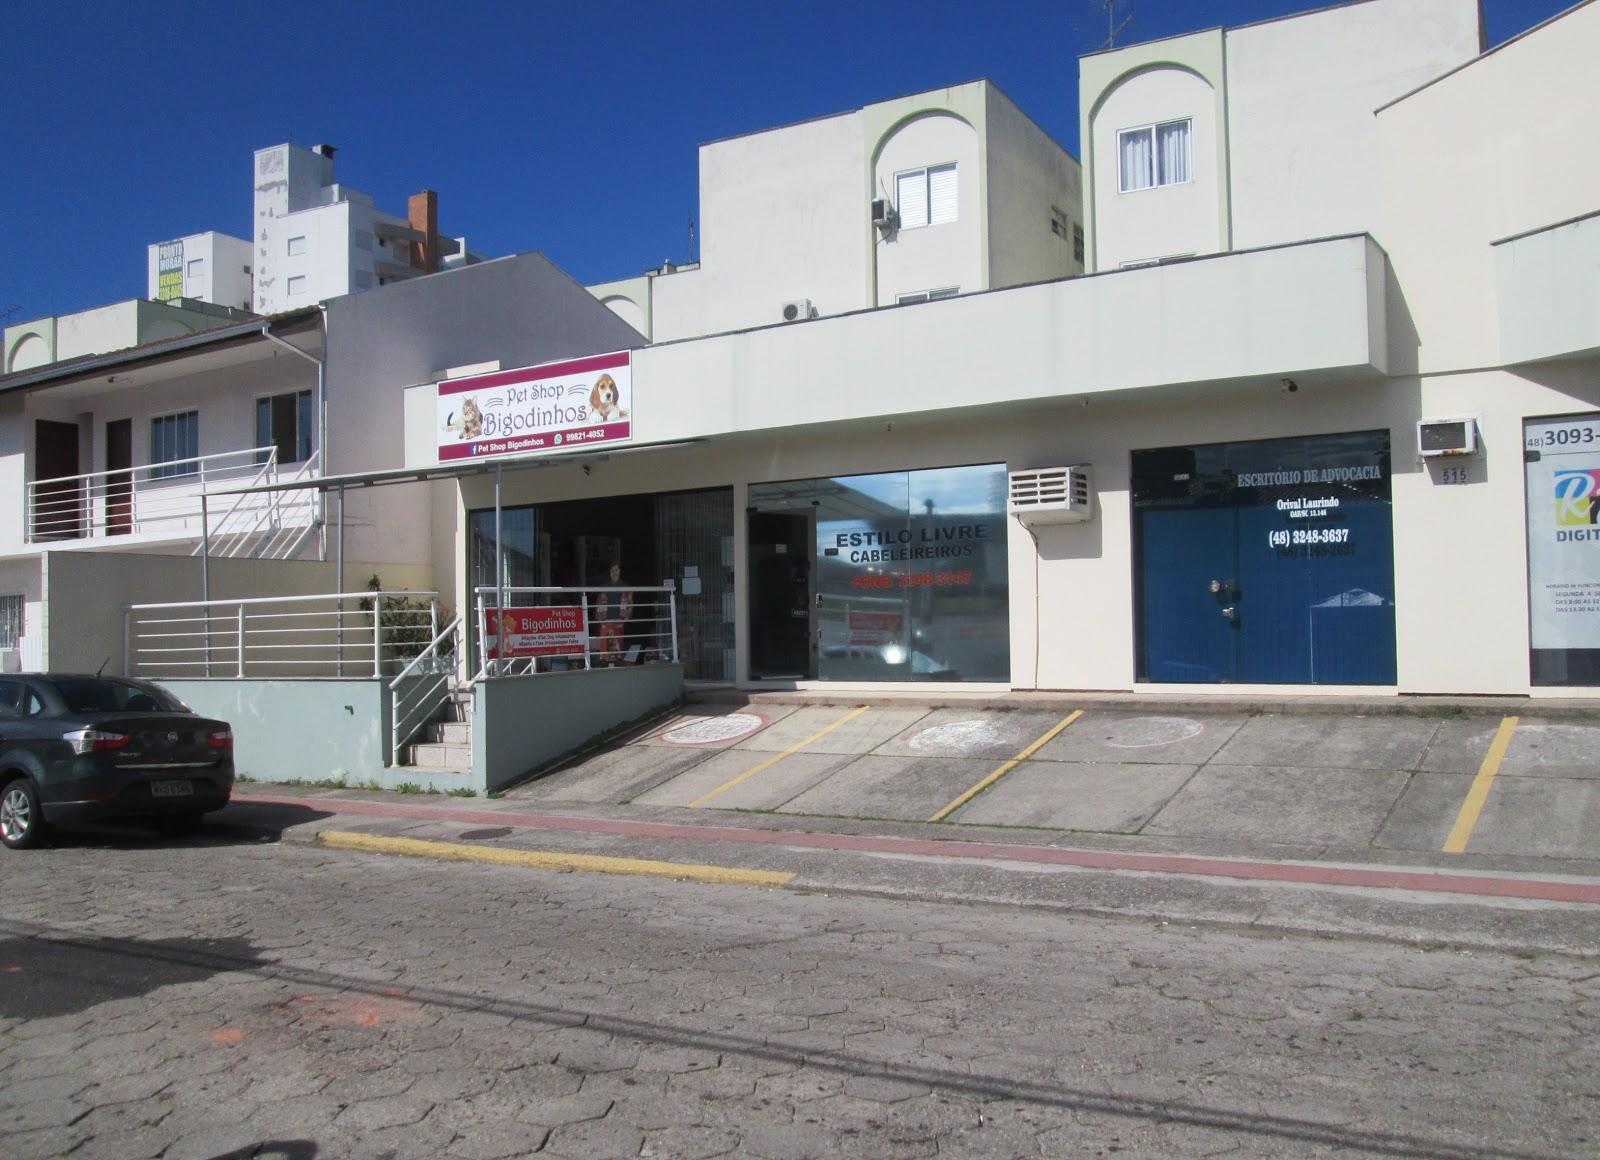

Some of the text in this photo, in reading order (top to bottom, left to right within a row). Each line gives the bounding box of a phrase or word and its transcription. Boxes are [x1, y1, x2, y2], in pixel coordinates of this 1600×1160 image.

[507, 385, 564, 406] Pet Shop
[483, 405, 587, 436] Bigodinhos
[566, 430, 605, 442] 99821-4052
[478, 438, 544, 453] Pet Shop Bigodinhos
[1304, 470, 1319, 483] DE
[1320, 466, 1381, 482] ADVOCACIA
[1277, 497, 1339, 510] Orival Laurindo
[836, 524, 991, 547] ESTILO LIVRE
[1269, 528, 1349, 548] (48) 3248-3637
[850, 545, 972, 563] CABELEIREIROS
[521, 617, 577, 633] Bigodinhos
